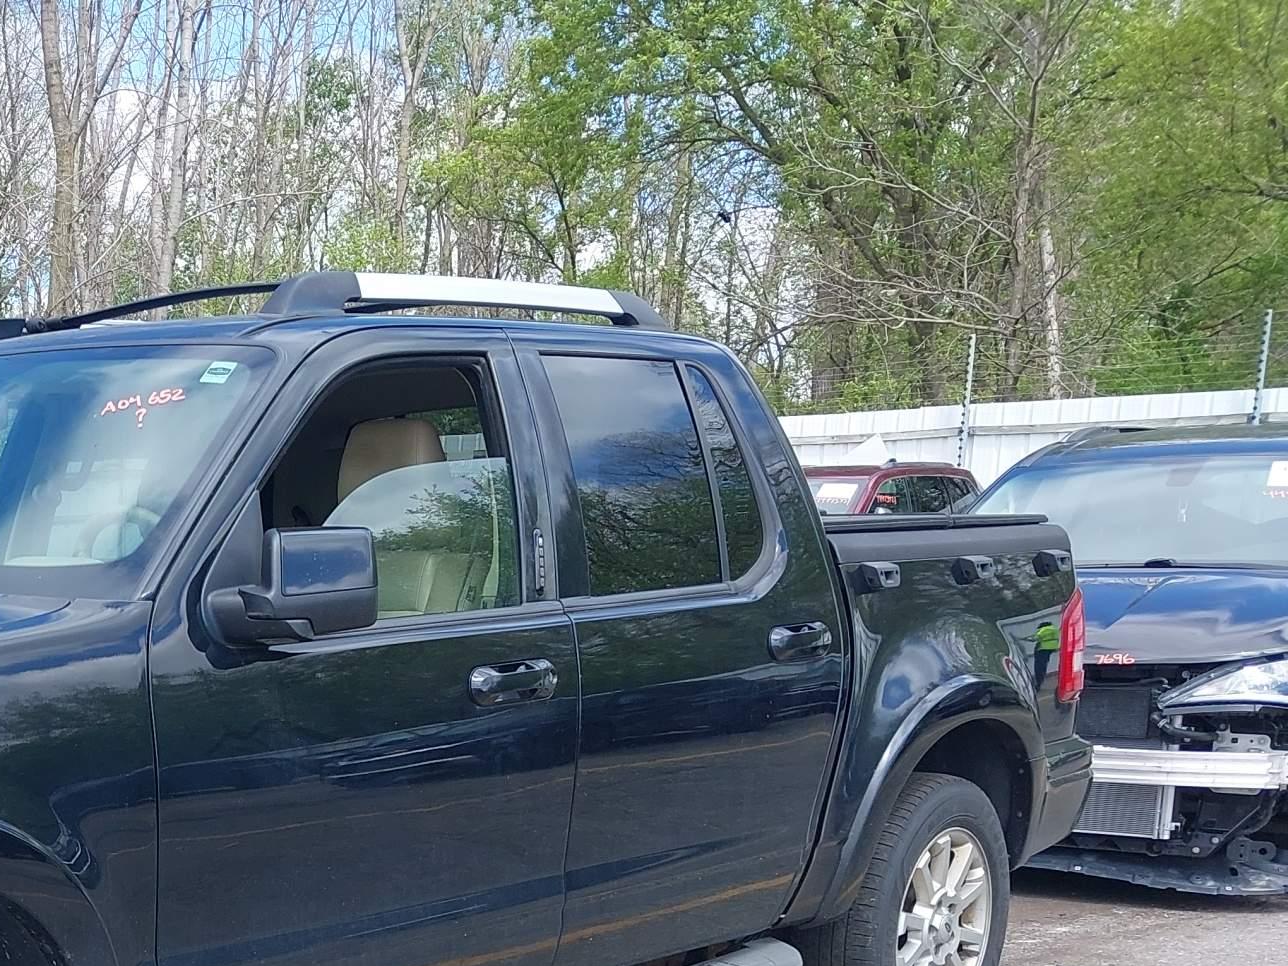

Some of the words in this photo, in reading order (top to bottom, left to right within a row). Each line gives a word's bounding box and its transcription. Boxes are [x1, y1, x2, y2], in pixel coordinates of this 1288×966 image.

[148, 388, 186, 406] 652
[136, 408, 147, 429] ?
[1094, 653, 1136, 665] 7696
